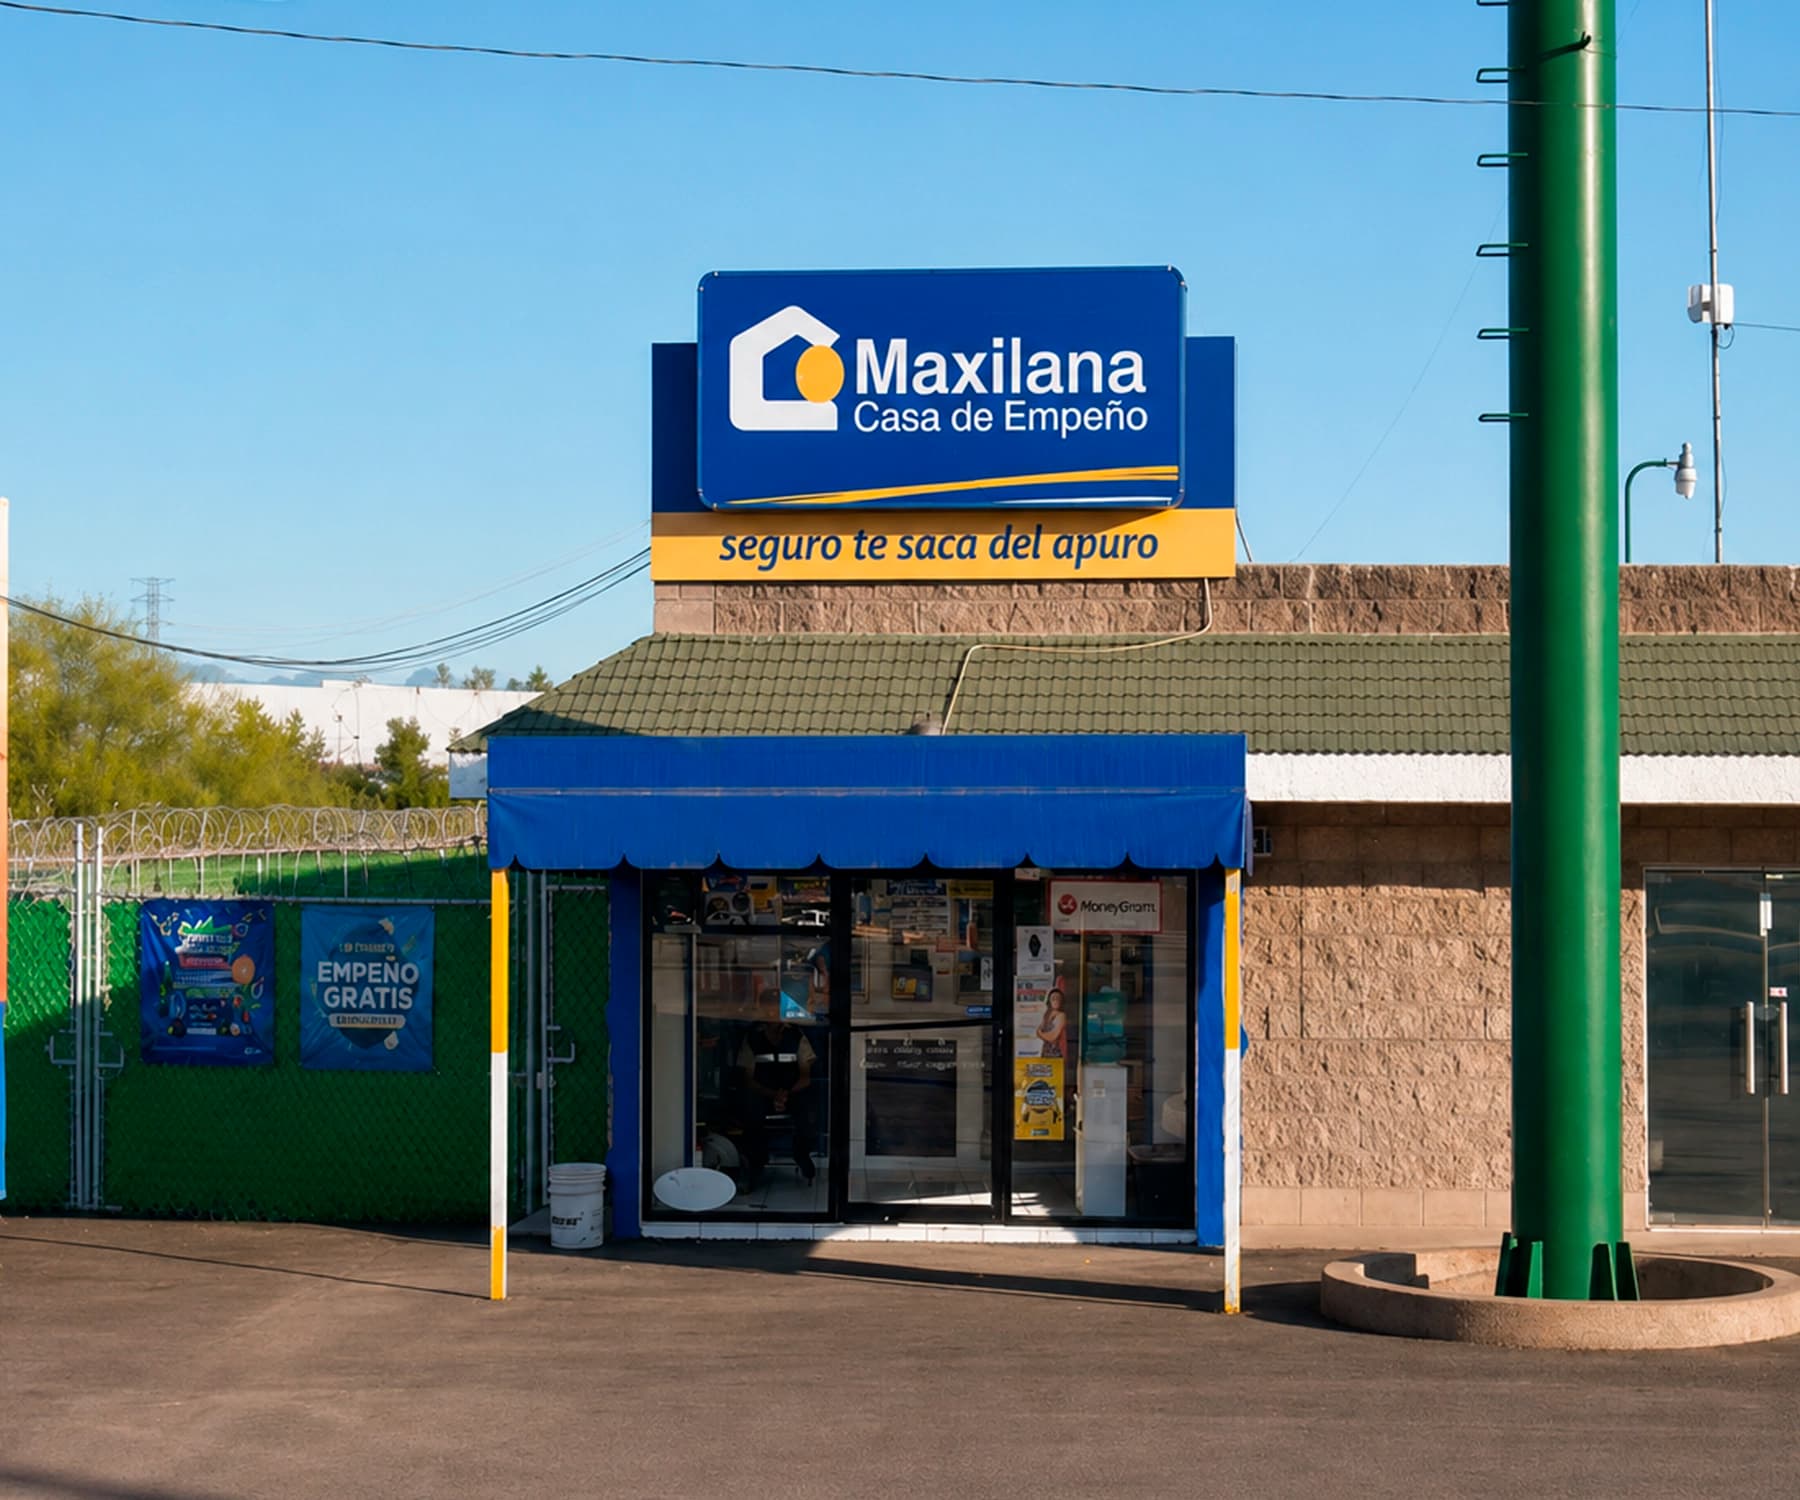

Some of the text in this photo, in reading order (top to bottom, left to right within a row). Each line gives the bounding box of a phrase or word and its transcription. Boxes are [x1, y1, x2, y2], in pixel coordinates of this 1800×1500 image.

[855, 336, 1147, 395] Maxilana
[854, 399, 1148, 439] Casa de Empeño
[719, 524, 1159, 571] seguro te saca del apuro
[1080, 900, 1158, 916] MoneyGram
[318, 955, 419, 985] EMPEÑO
[323, 986, 413, 1010] GRATIS
